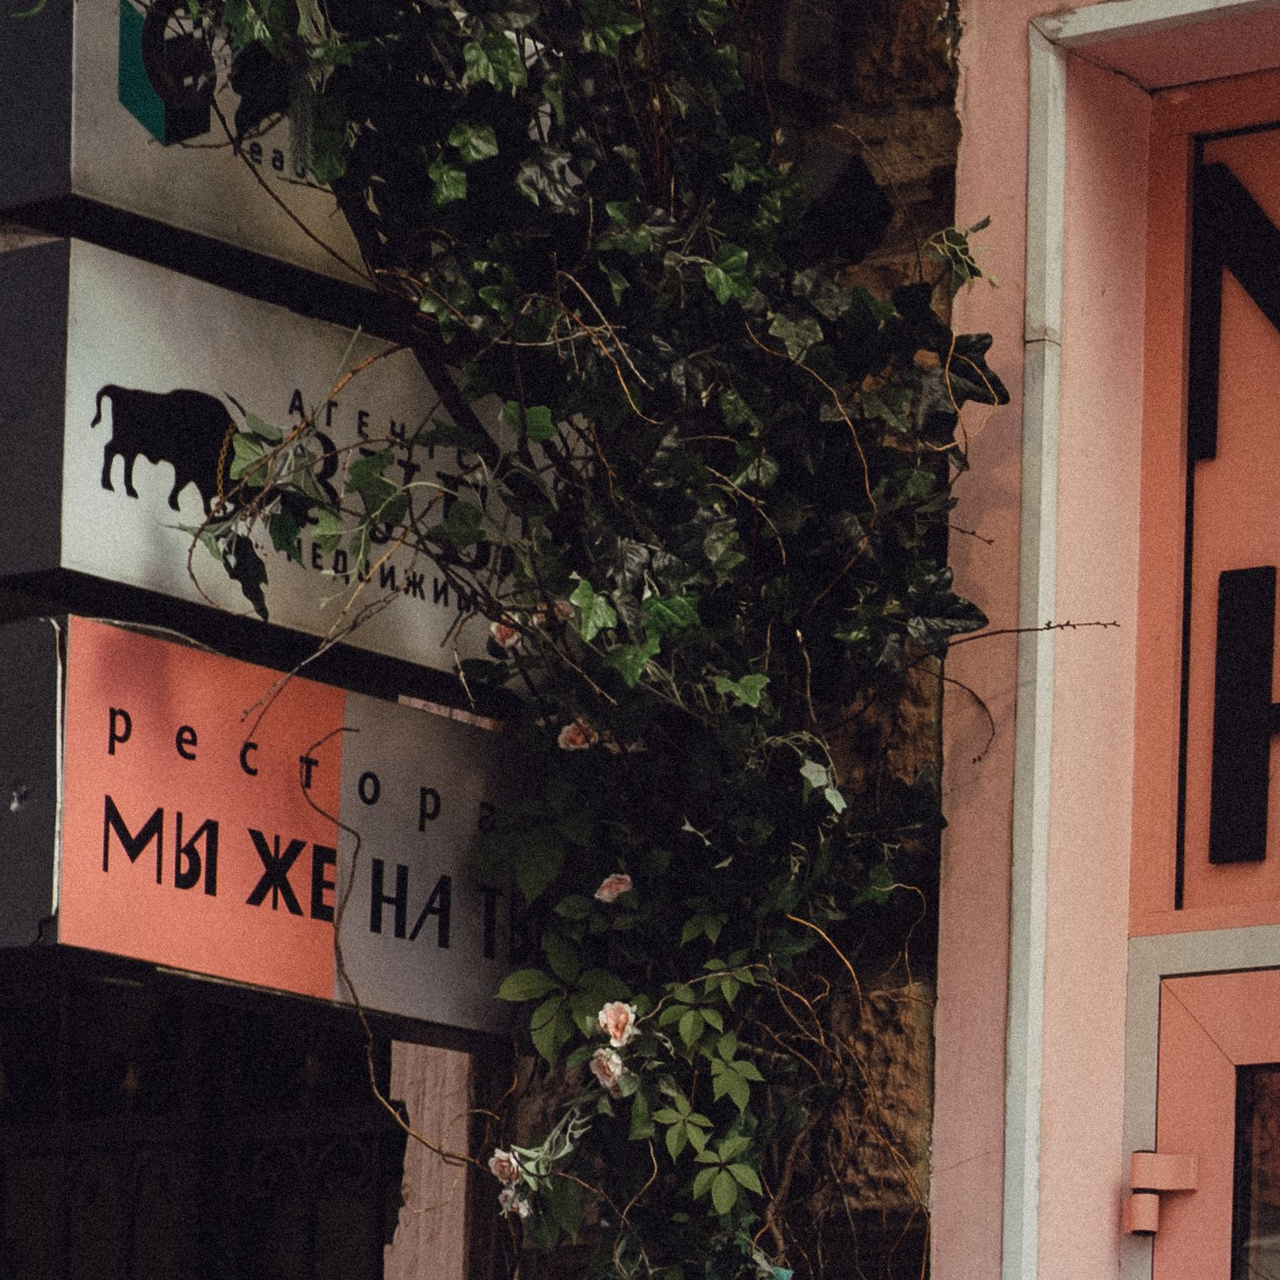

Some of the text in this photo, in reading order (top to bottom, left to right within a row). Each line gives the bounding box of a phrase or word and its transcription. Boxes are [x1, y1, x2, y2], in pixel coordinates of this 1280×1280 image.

[107, 705, 497, 833] рестора
[102, 794, 219, 897] МЫ
[245, 827, 338, 924] ЖЕ
[369, 857, 453, 949] НА
